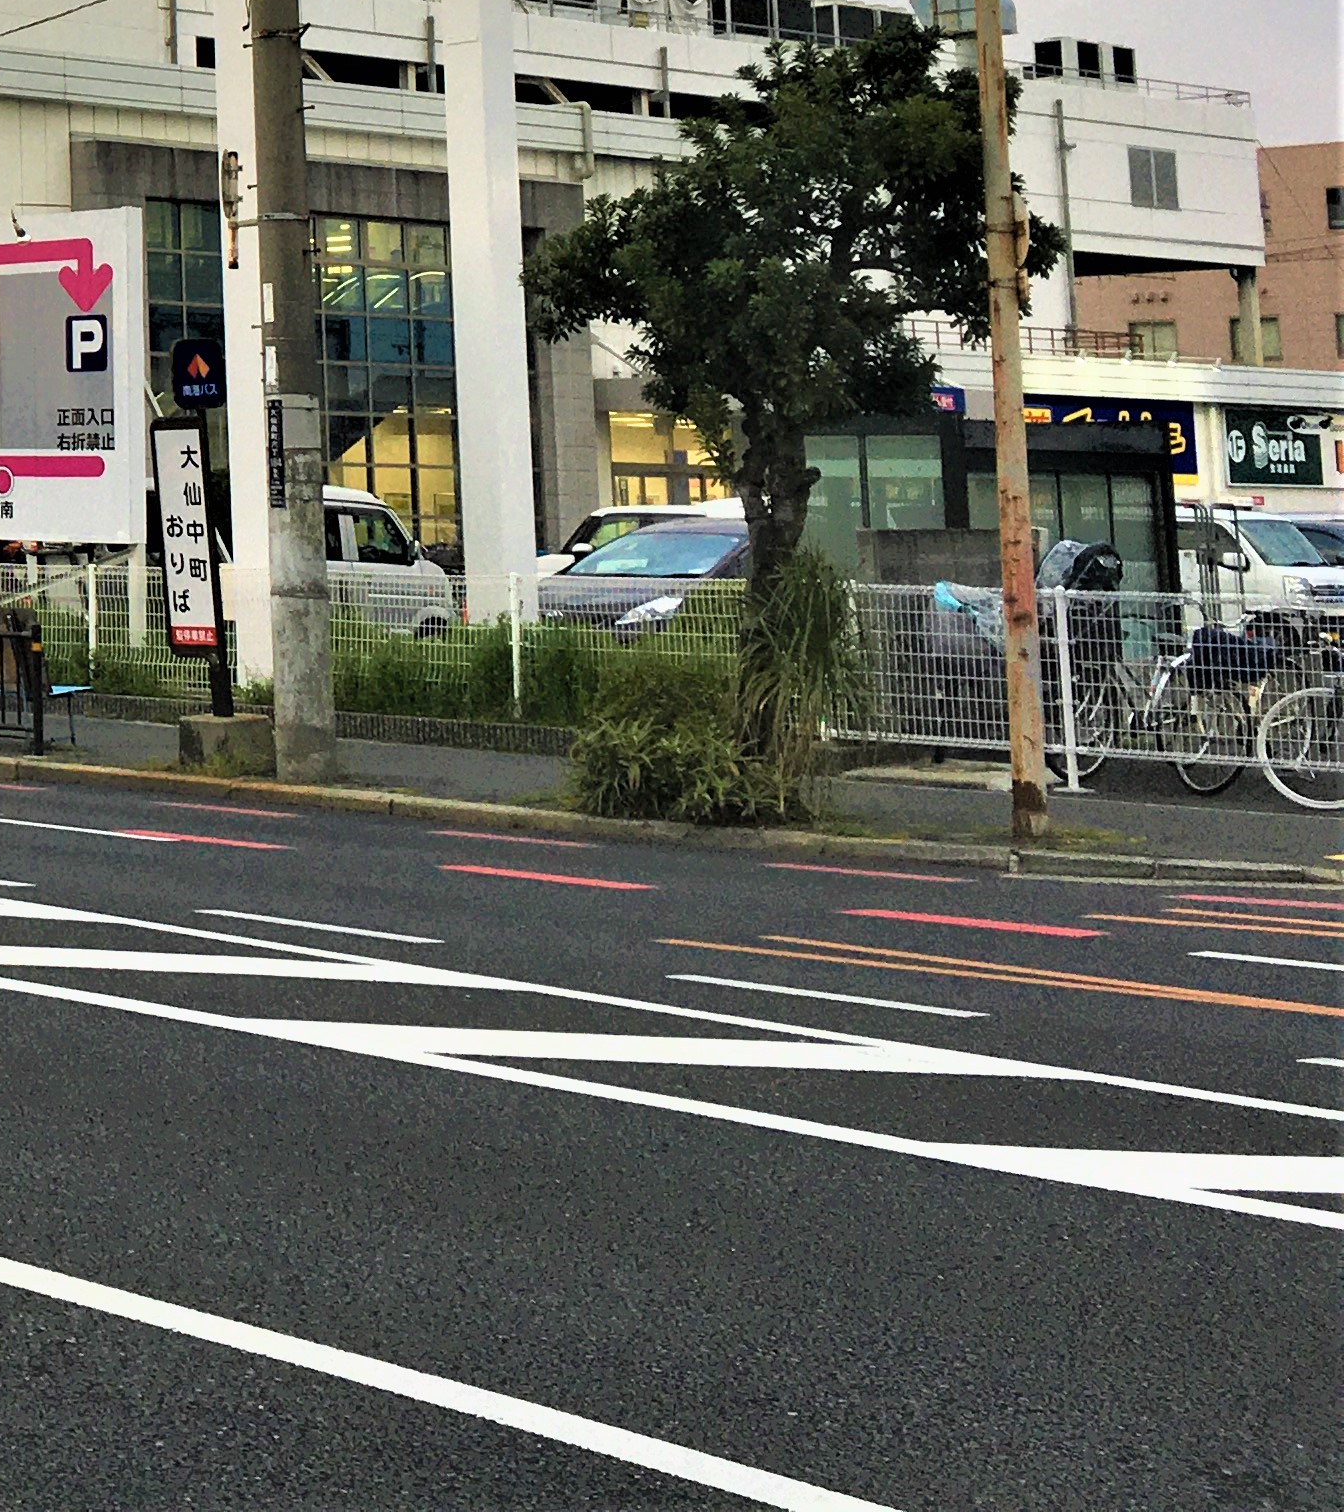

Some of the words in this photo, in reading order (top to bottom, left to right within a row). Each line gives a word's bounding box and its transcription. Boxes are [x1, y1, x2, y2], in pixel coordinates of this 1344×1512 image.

[71, 319, 104, 370] P
[56, 408, 115, 427] 正面入口
[56, 432, 115, 451] 右折禁止
[1252, 423, 1306, 464] Seria
[180, 444, 208, 582] 大仙中町
[166, 514, 191, 613] おりば
